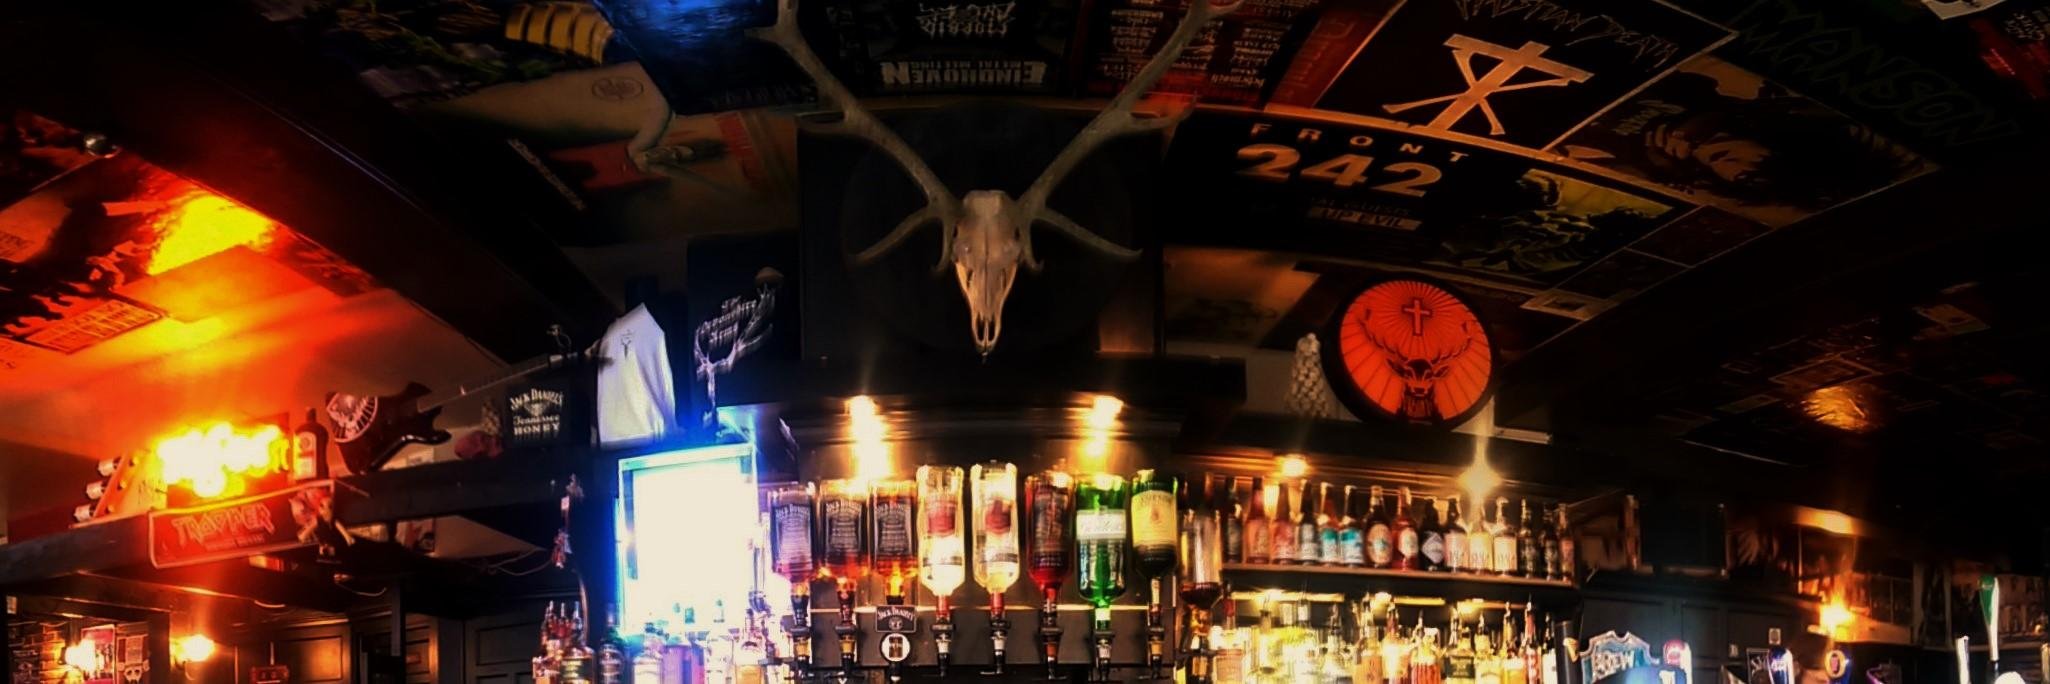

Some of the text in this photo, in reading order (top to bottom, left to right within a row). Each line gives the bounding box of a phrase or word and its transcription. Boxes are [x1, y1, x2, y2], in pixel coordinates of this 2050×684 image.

[880, 60, 1047, 87] EINDHOVEN
[1728, 0, 2024, 147] MANSON
[1250, 123, 1469, 162] FRONT
[1235, 143, 1442, 197] 242
[514, 423, 560, 436] HONEY
